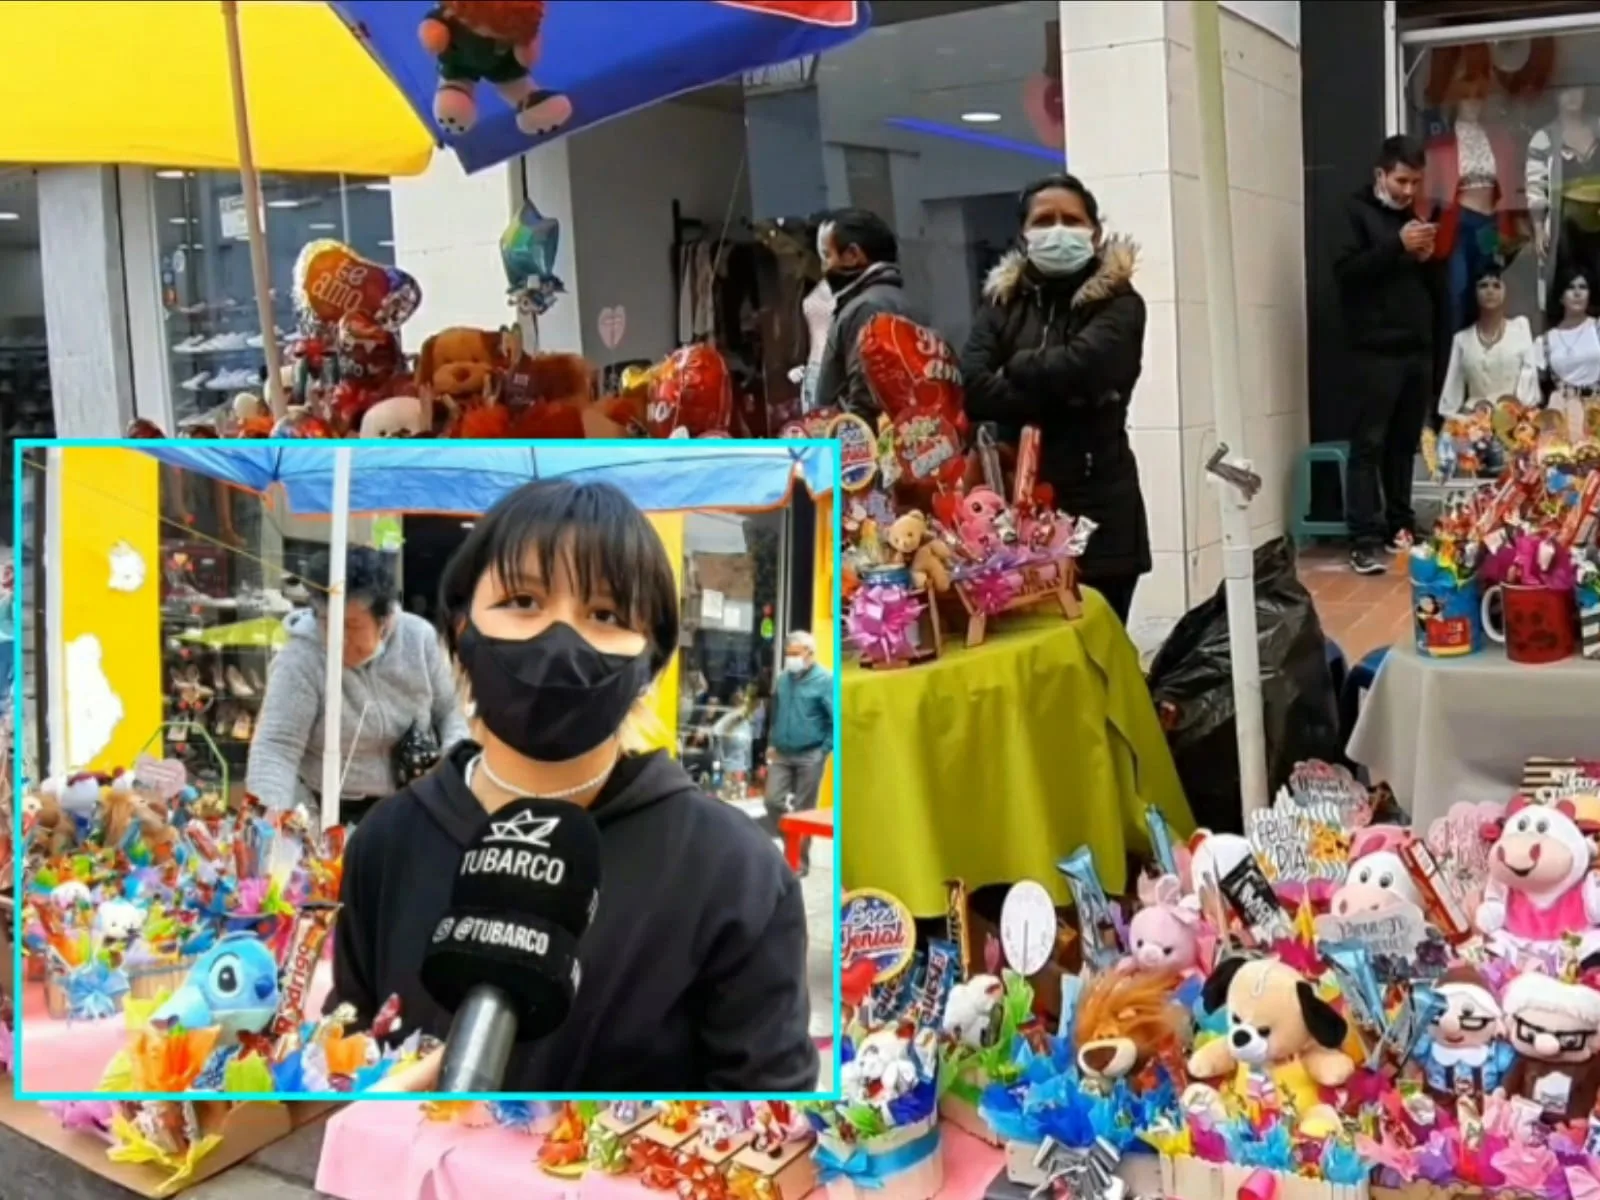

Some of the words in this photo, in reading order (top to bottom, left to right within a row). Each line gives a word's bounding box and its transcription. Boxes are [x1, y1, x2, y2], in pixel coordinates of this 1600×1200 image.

[311, 271, 364, 314] amo
[460, 847, 566, 885] TUBARCO
[851, 898, 898, 927] Eres
[453, 915, 549, 956] @TUBARCO
